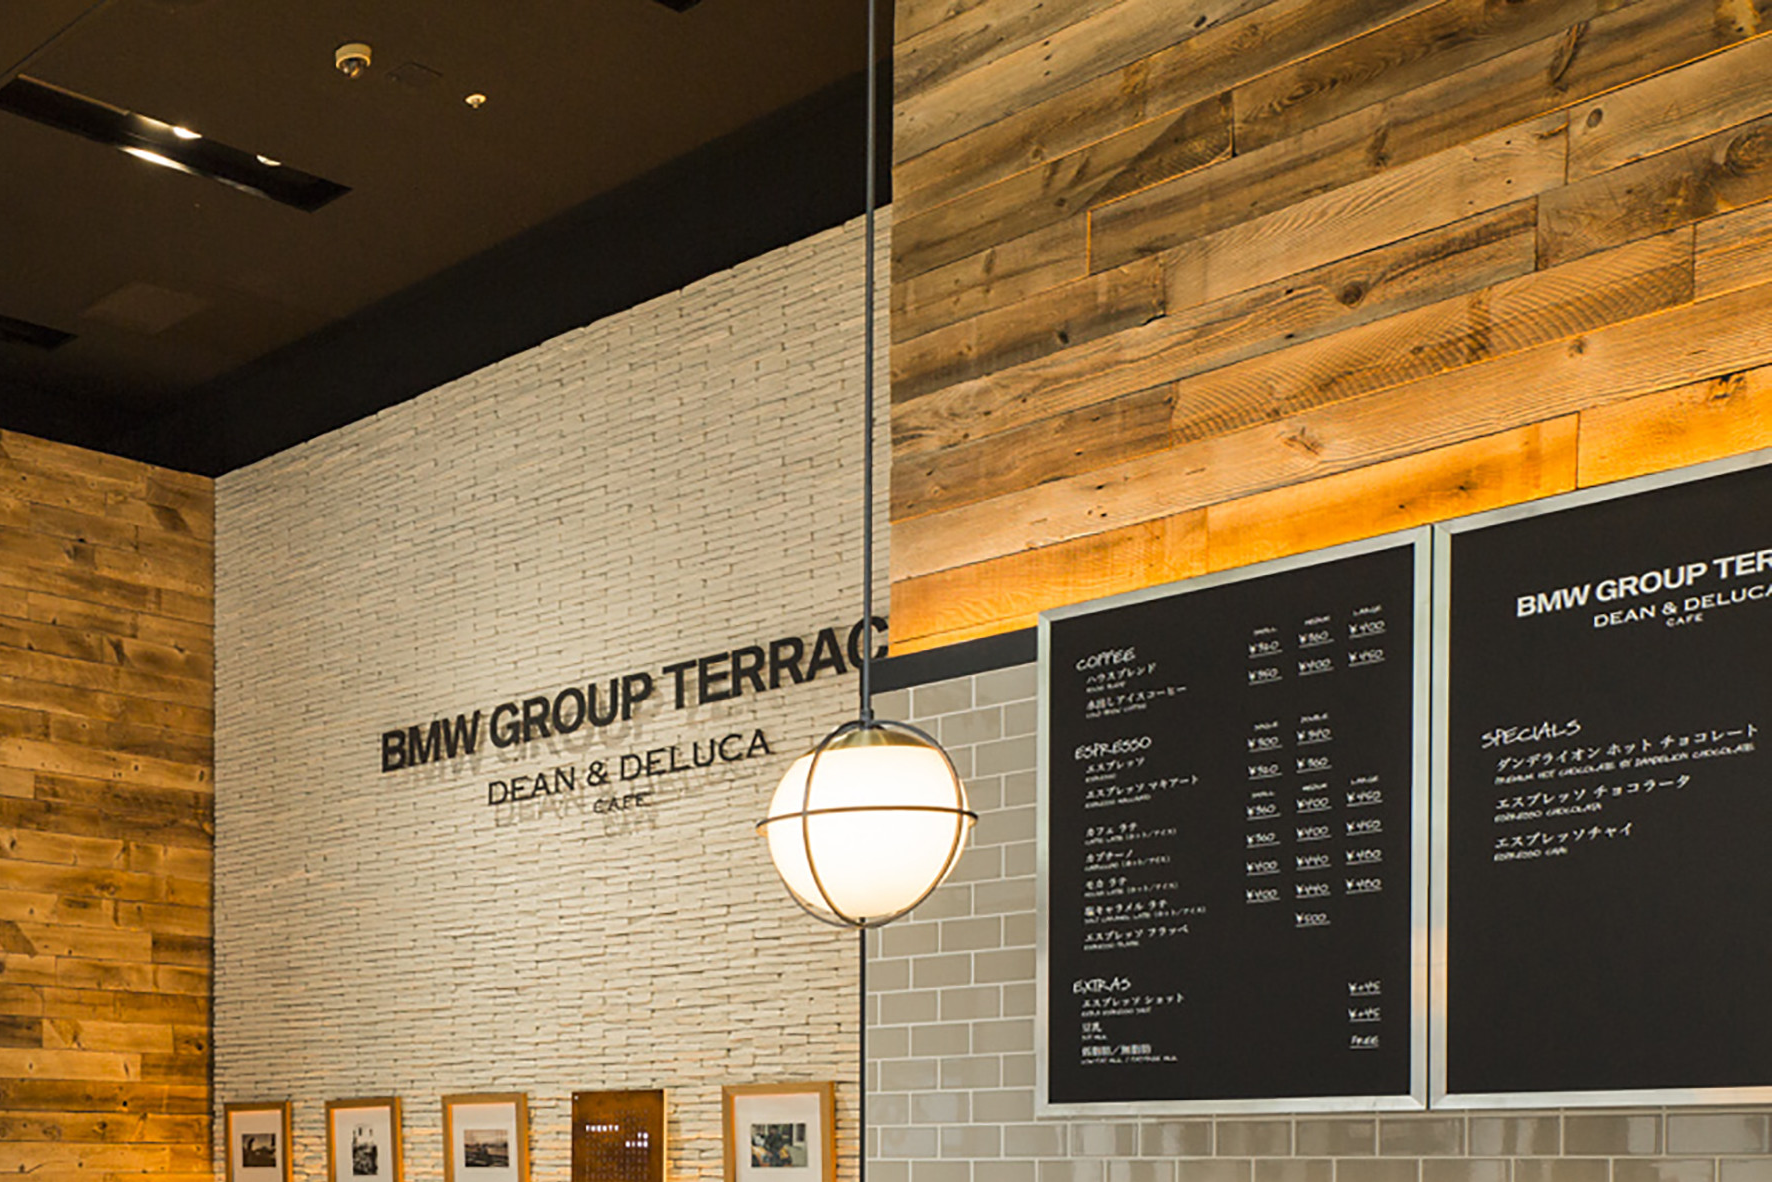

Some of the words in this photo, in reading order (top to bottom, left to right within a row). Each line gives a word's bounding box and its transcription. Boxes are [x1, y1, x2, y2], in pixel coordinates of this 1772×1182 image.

[1516, 583, 1592, 618] BMW
[1594, 562, 1708, 604] GROUP
[1593, 604, 1656, 628] DEAN
[1662, 601, 1677, 616] &
[1666, 612, 1704, 627] CAFE
[1075, 646, 1136, 671] COFFEE
[1085, 662, 1157, 684] ハウスブレンド
[380, 710, 481, 773] BMW
[489, 672, 653, 748] GROUP
[1481, 719, 1582, 749] SPECIALS
[1075, 736, 1152, 760] ESPRESSO
[1496, 746, 1601, 772] ダンデライオン
[1605, 739, 1652, 757] ホット
[1659, 723, 1759, 748] チョコレート
[487, 766, 576, 806] DEAN
[586, 760, 609, 785] &
[619, 728, 772, 782] DELUCA
[1086, 757, 1145, 774] エスプレッソ
[592, 791, 652, 814] CAFE
[1086, 783, 1145, 800] エスプレッソ
[1495, 787, 1587, 810] エスプレッソ
[1593, 774, 1691, 799] チョコラータ
[1494, 822, 1633, 849] エスプレッソチャイ
[1084, 928, 1143, 942] エスプレッソ
[1073, 976, 1132, 994] EXTRAS
[1082, 995, 1141, 1009] エスプレッソ
